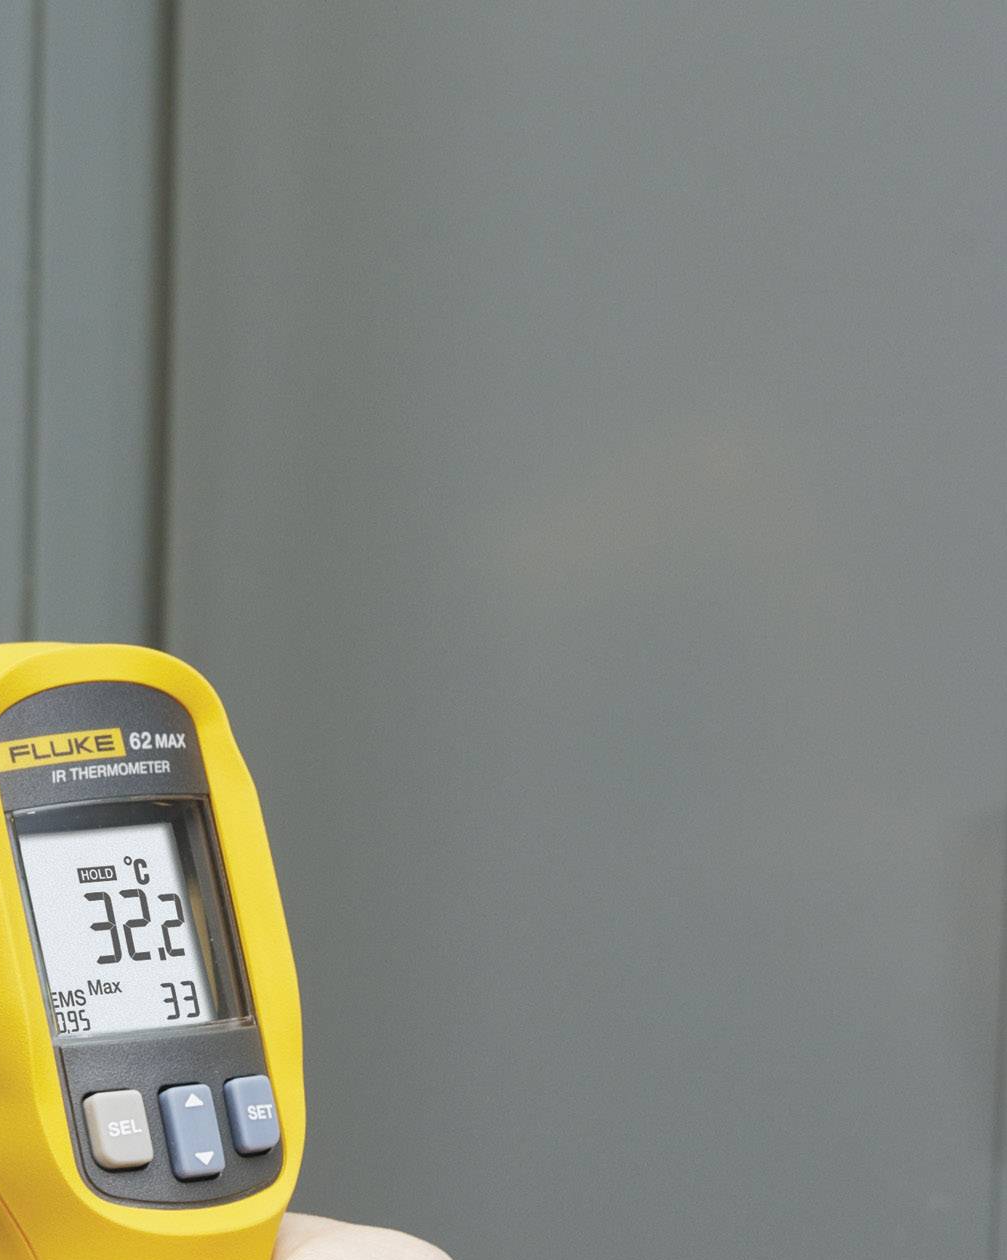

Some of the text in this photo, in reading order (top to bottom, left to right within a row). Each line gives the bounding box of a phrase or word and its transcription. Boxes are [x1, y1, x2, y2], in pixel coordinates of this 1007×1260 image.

[9, 732, 186, 763] FLUKE 62 MAX
[52, 760, 171, 783] IR THERMOMETER
[80, 867, 114, 881] HOLD
[87, 979, 122, 996] Max
[51, 989, 86, 1007] EMS
[160, 980, 200, 1020] 33
[248, 1104, 272, 1120] SET
[108, 1120, 142, 1137] SEL
